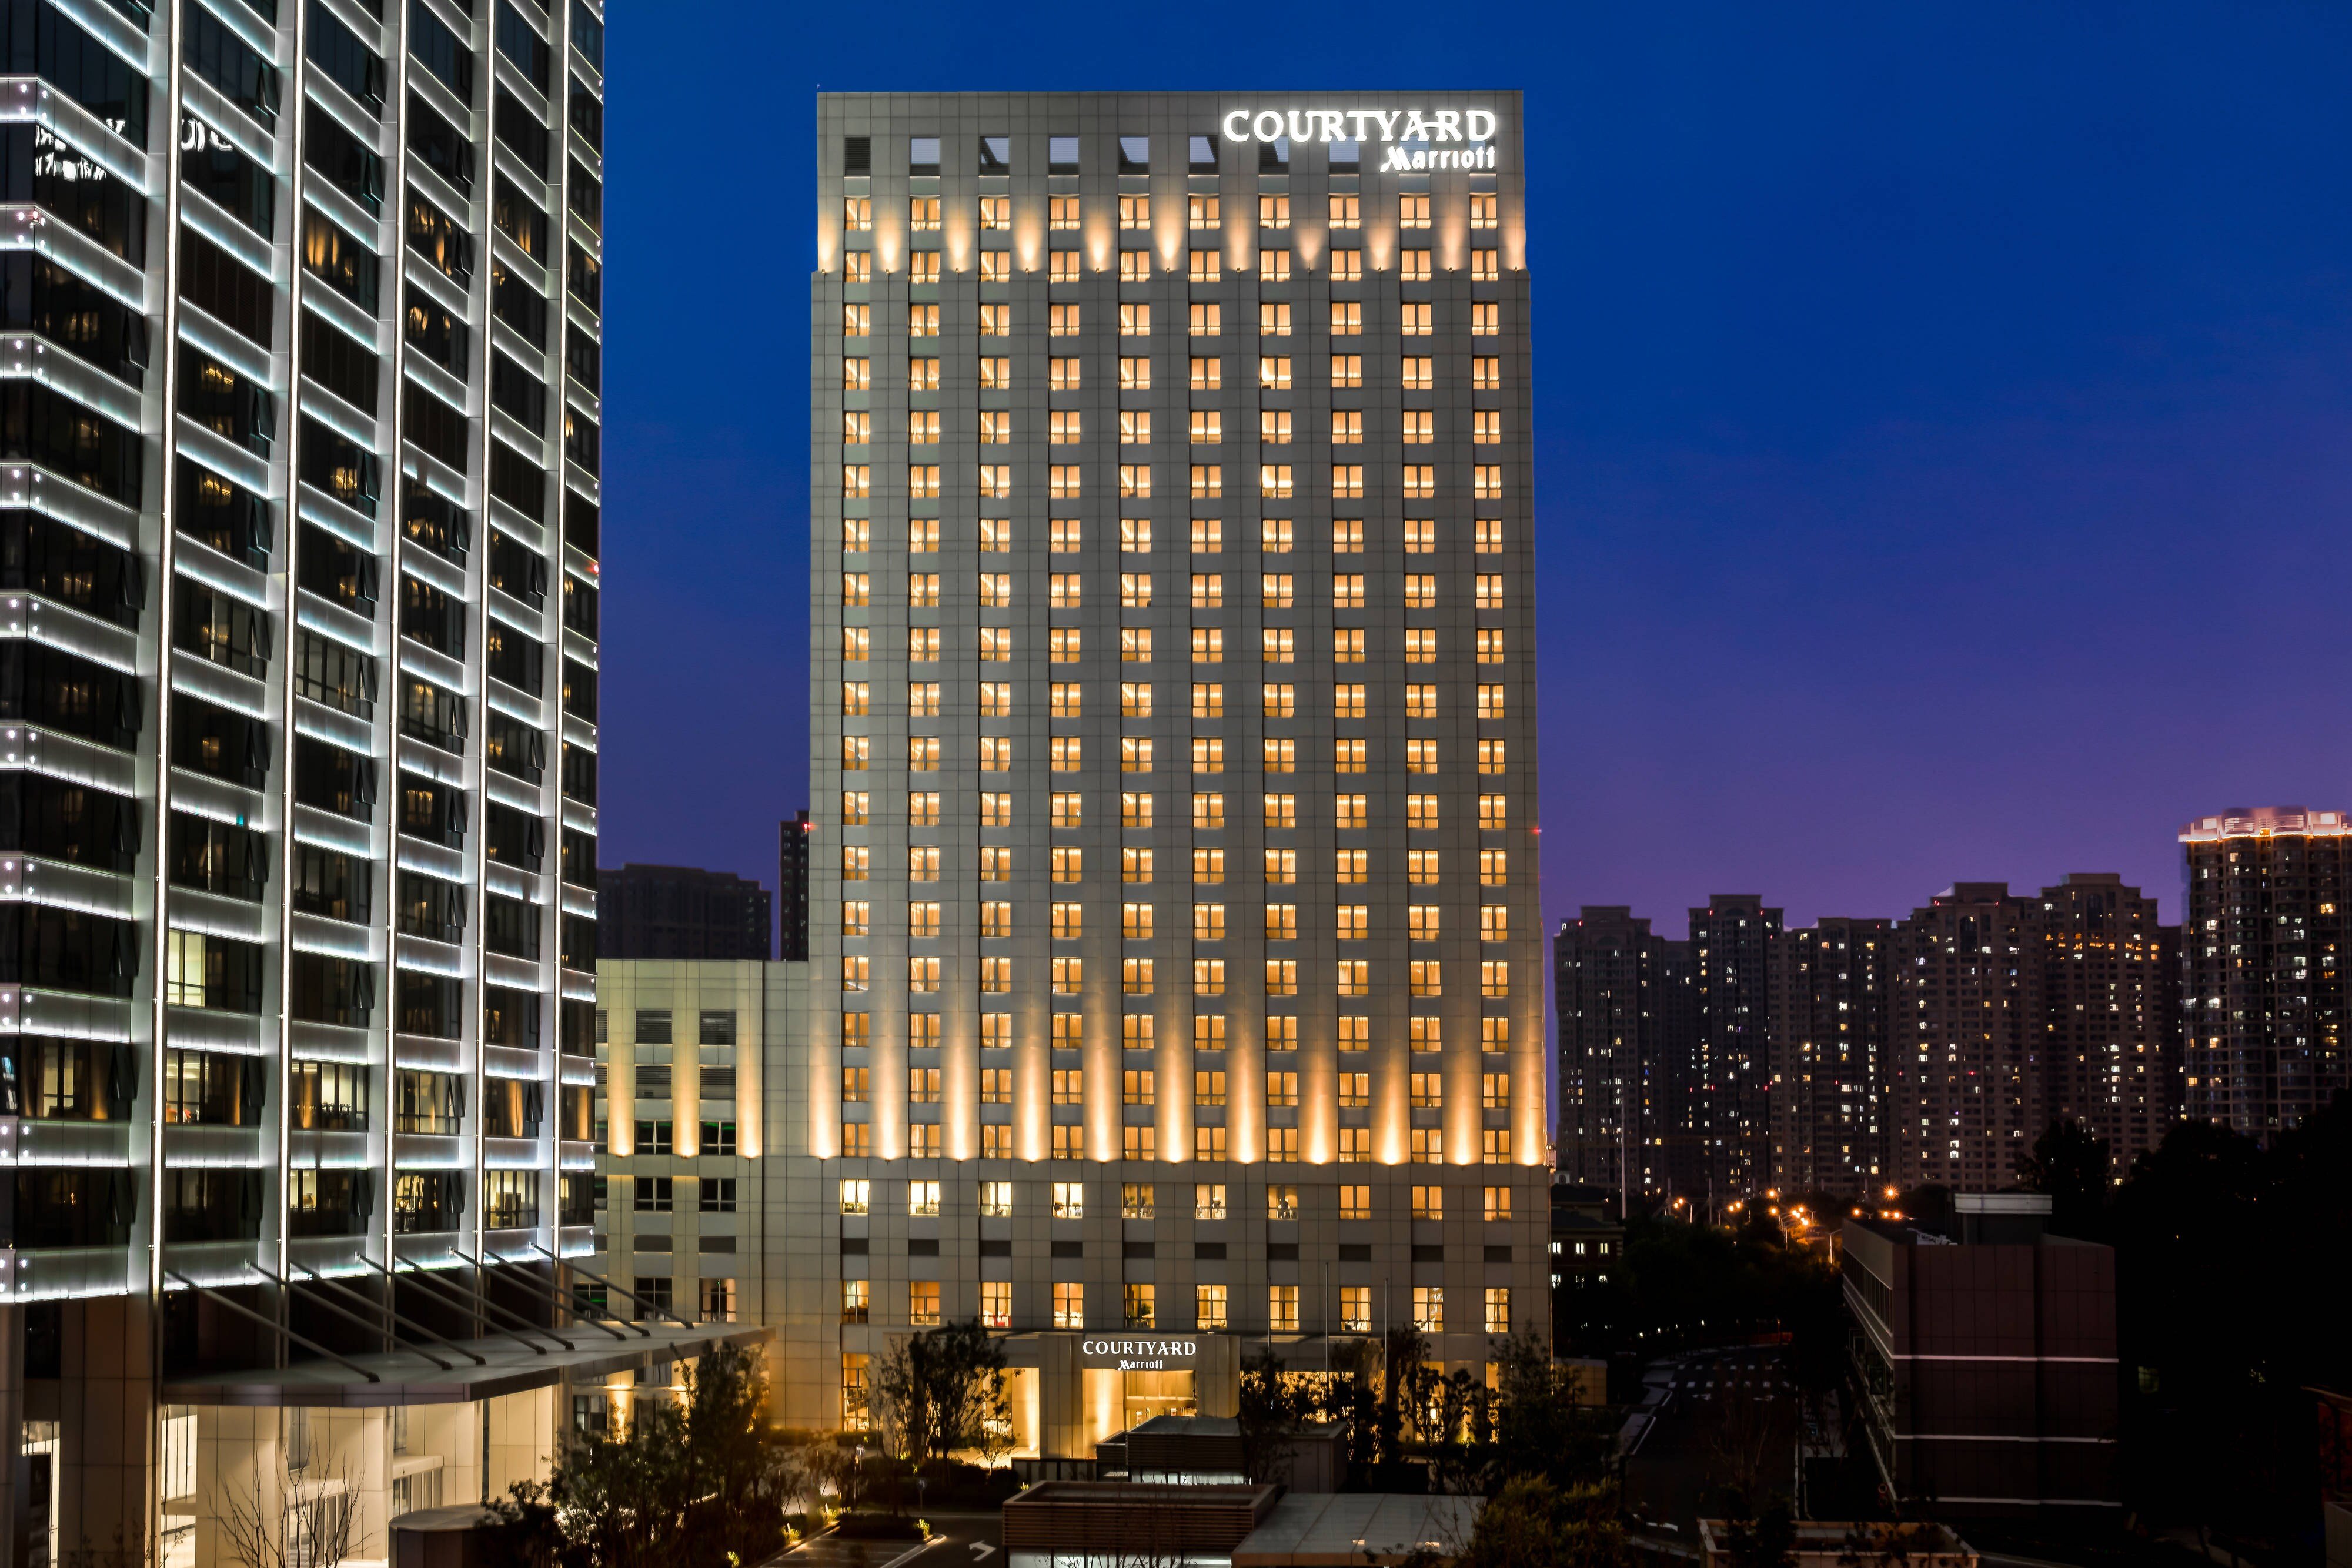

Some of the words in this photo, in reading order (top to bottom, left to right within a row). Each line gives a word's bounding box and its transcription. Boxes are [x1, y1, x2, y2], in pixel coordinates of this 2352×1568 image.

[1223, 109, 1496, 142] COURTYARD
[1379, 145, 1496, 173] Marriott
[1083, 1340, 1196, 1356] COURTYARD
[1117, 1359, 1163, 1371] Marriott
